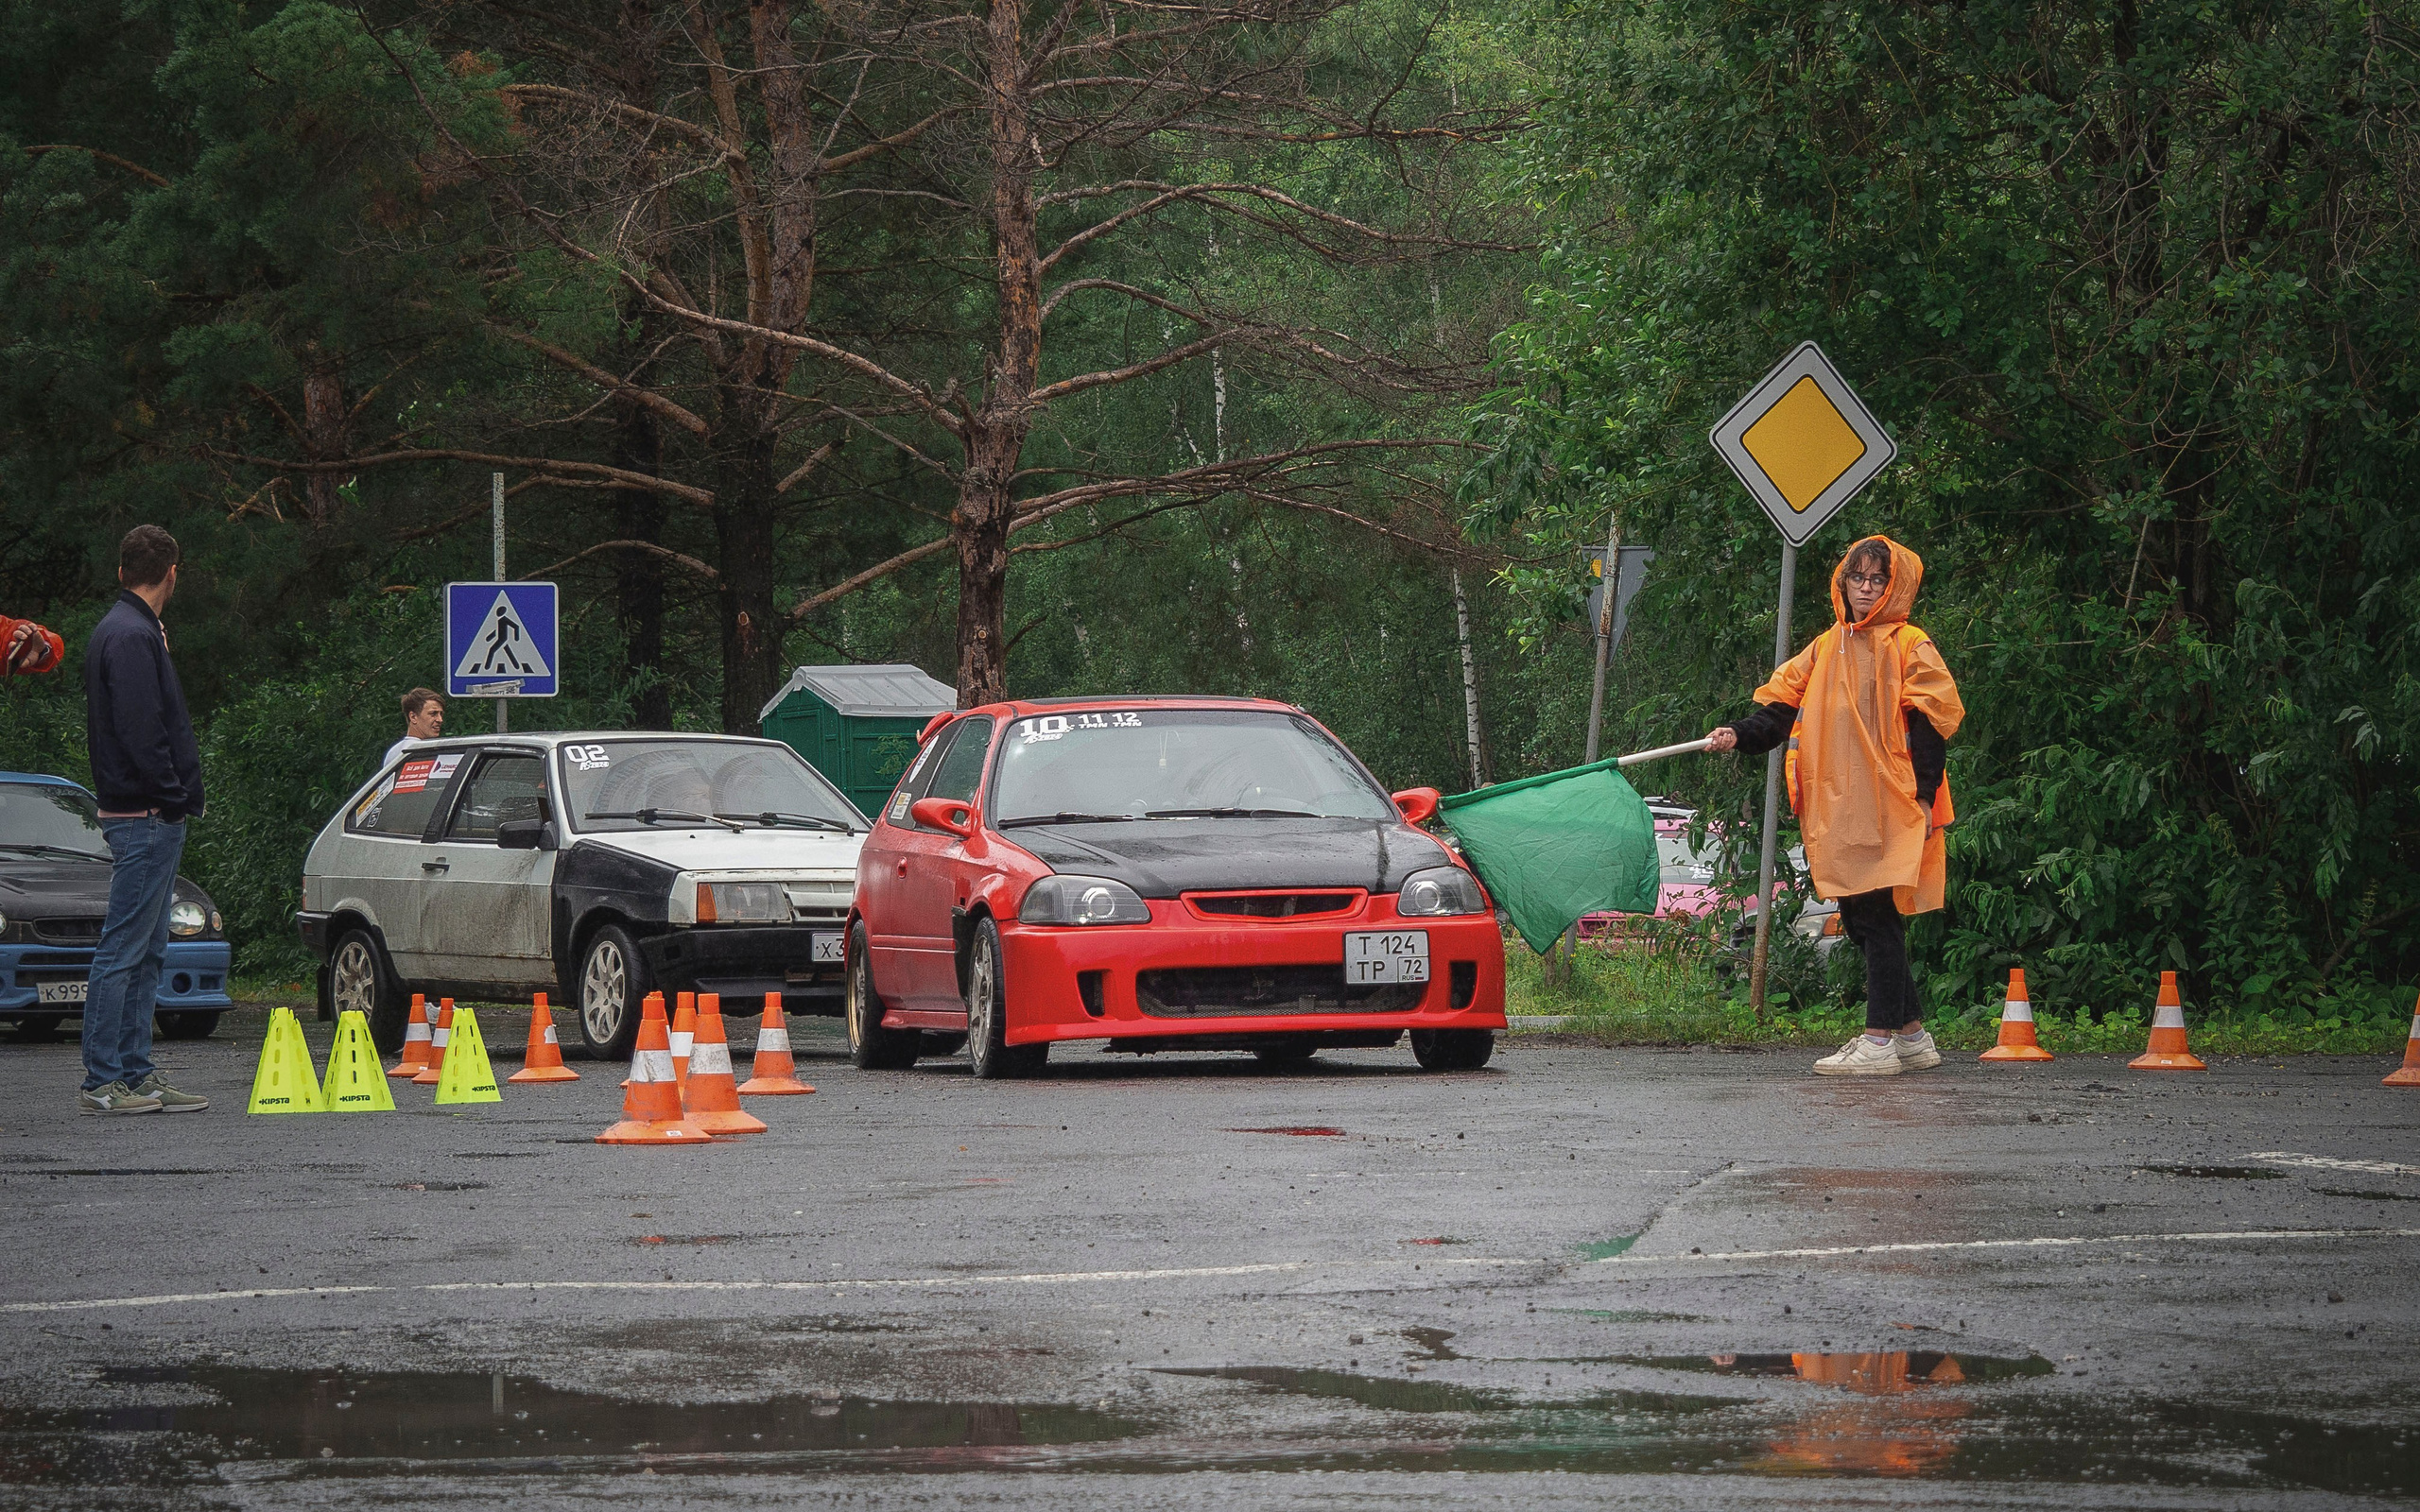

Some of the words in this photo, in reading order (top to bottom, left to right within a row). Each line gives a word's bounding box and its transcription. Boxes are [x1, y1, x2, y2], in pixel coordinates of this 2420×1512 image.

[1078, 713, 1103, 724] 11
[1112, 712, 1139, 723] 12
[564, 745, 610, 763] 02
[1380, 935, 1415, 954] 124
[1357, 960, 1386, 980] ТР
[1404, 959, 1422, 974] 72
